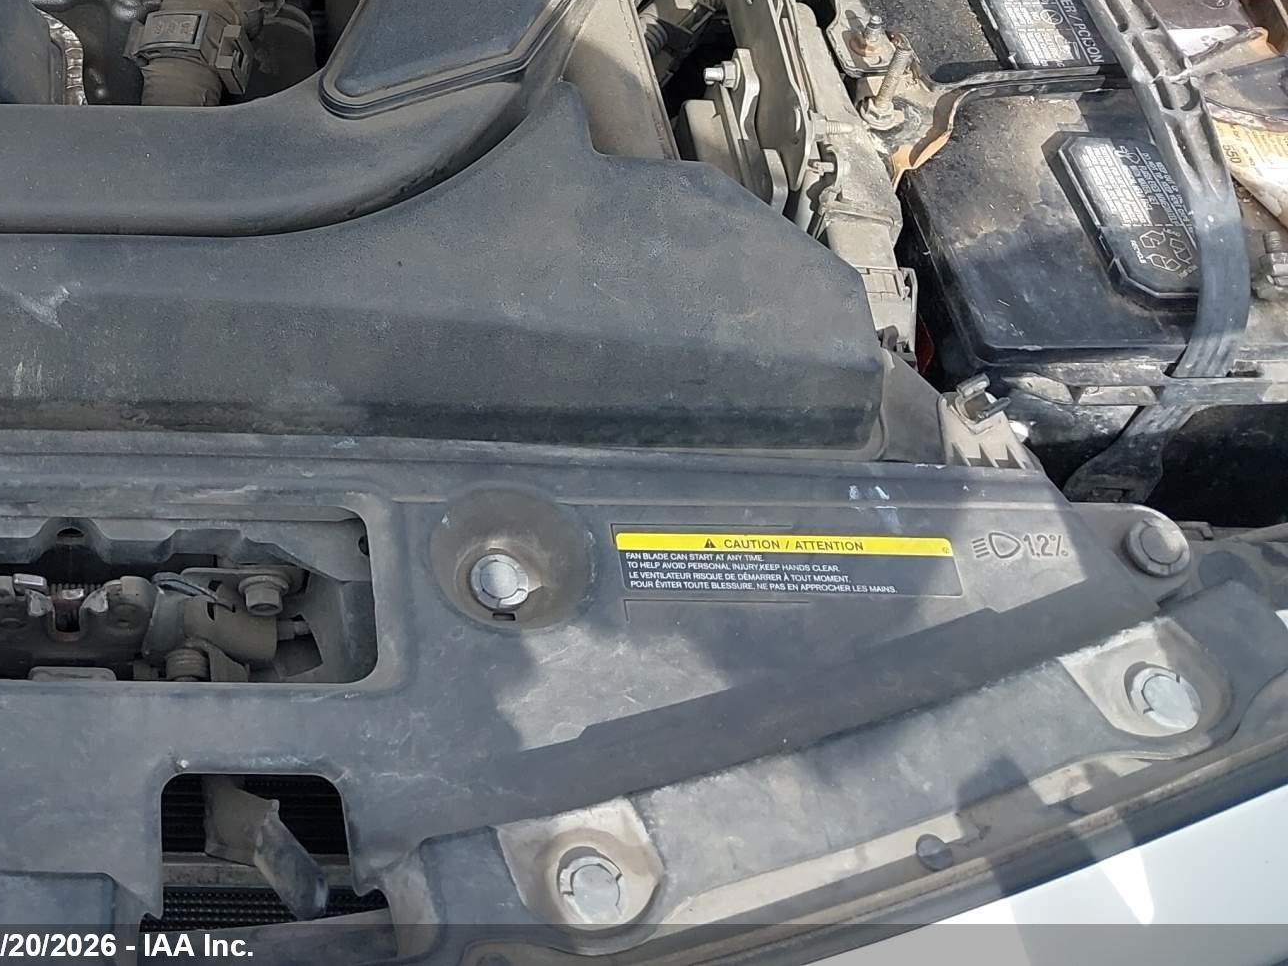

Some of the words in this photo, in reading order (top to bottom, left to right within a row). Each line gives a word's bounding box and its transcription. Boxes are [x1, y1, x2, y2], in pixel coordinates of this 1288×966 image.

[724, 539, 780, 550] CAUTION
[795, 541, 864, 551] ATTENTION
[1024, 534, 1069, 558] 1.2%
[641, 572, 691, 580] VENTILATEUR
[737, 572, 781, 581] DÉMARRER
[784, 572, 789, 581] À
[791, 574, 811, 582] TOUT
[814, 575, 851, 583] MOMENT.
[656, 578, 682, 588] ÉVITER
[756, 582, 768, 590] NE
[770, 583, 785, 591] PAS
[787, 584, 799, 592] EN
[801, 584, 850, 593] APPROCHER
